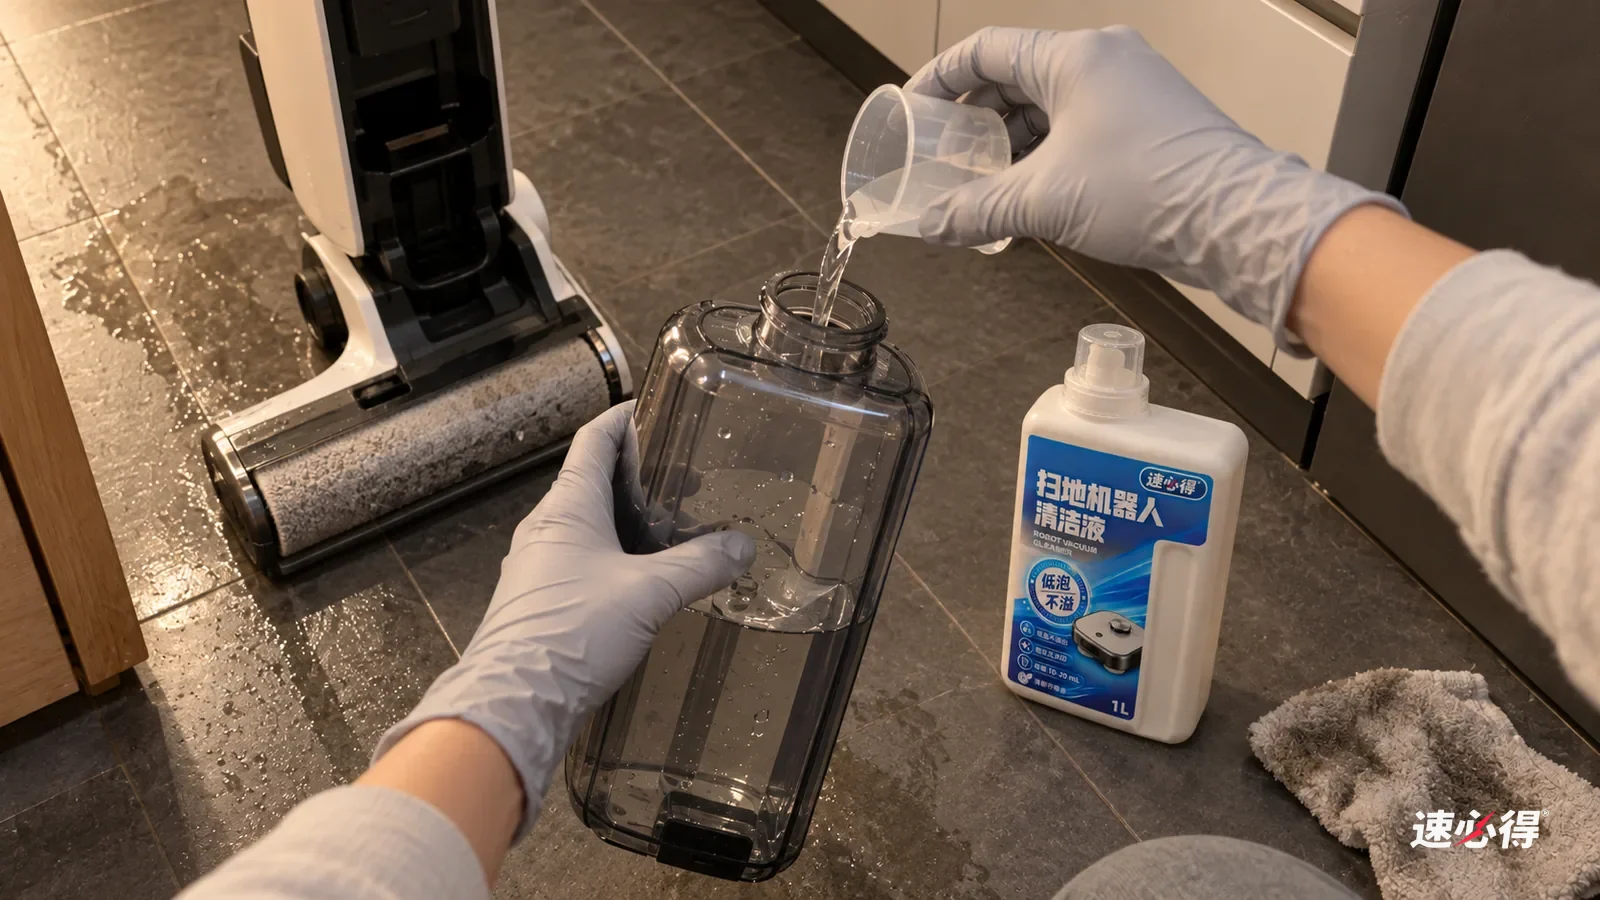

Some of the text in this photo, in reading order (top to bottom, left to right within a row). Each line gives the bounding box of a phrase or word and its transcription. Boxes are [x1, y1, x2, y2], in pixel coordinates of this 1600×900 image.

[1036, 469, 1164, 528] 扫地机器人
[1034, 500, 1106, 544] 清洁液
[1033, 529, 1098, 554] ROBOT VACUUM
[1041, 573, 1071, 591] 低泡
[1045, 594, 1075, 611] 不溢
[1111, 700, 1129, 716] 1L
